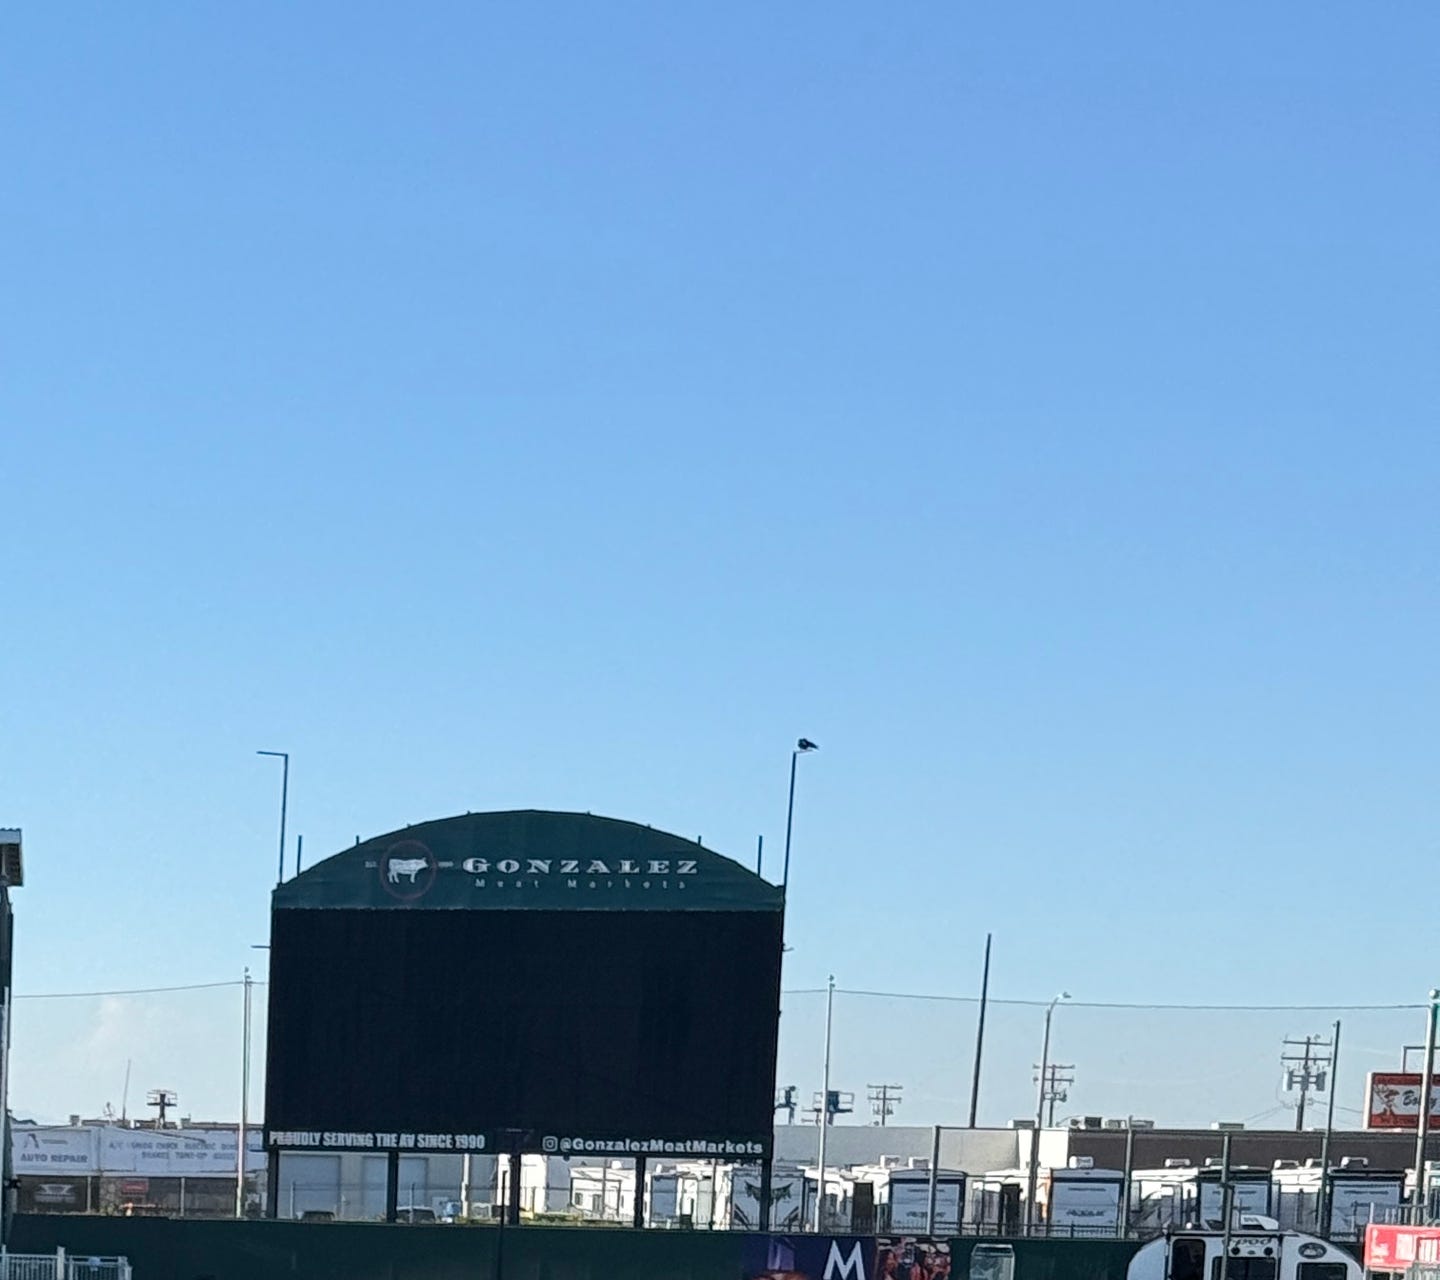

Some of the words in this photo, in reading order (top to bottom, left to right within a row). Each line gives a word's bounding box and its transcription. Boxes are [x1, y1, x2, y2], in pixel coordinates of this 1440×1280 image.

[462, 857, 698, 874] GONZALEZ
[475, 878, 540, 889] Meat
[567, 879, 686, 890] Markets
[269, 1131, 322, 1146] PROUDLY
[323, 1132, 374, 1147] SERVING
[376, 1133, 398, 1147] THE
[400, 1134, 415, 1147] AV
[417, 1134, 453, 1148] SINCE
[455, 1135, 486, 1149] 1990
[560, 1138, 763, 1154] @GonzalezMeatMarkets
[20, 1153, 47, 1163] AUTO
[51, 1154, 88, 1164] REPAIR
[822, 1240, 866, 1280] M
